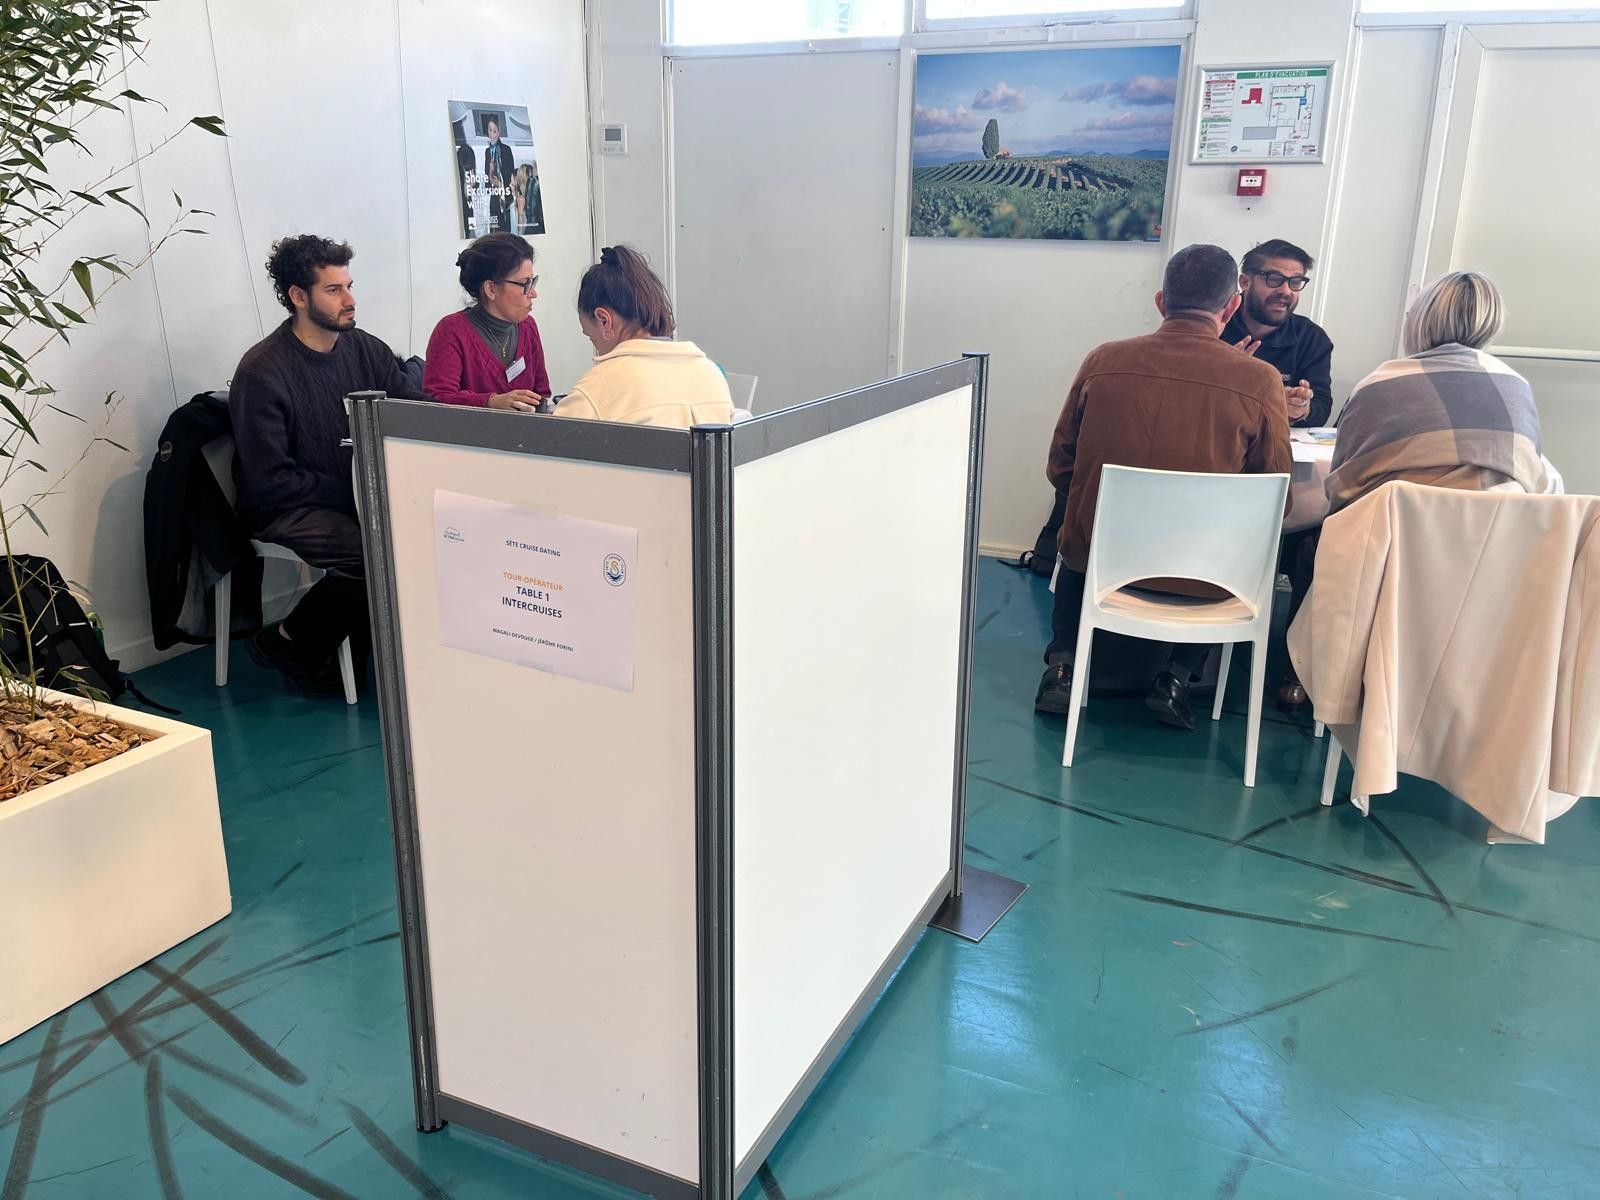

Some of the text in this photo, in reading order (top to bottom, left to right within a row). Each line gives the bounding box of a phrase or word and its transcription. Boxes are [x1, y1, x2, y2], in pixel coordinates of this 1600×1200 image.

[467, 184, 511, 196] Excursions
[519, 543, 539, 552] CRUISE
[539, 547, 561, 557] DATING
[516, 586, 549, 602] TABLE 1
[502, 596, 562, 618] INTERCRUISES
[492, 627, 511, 636] MAGALI
